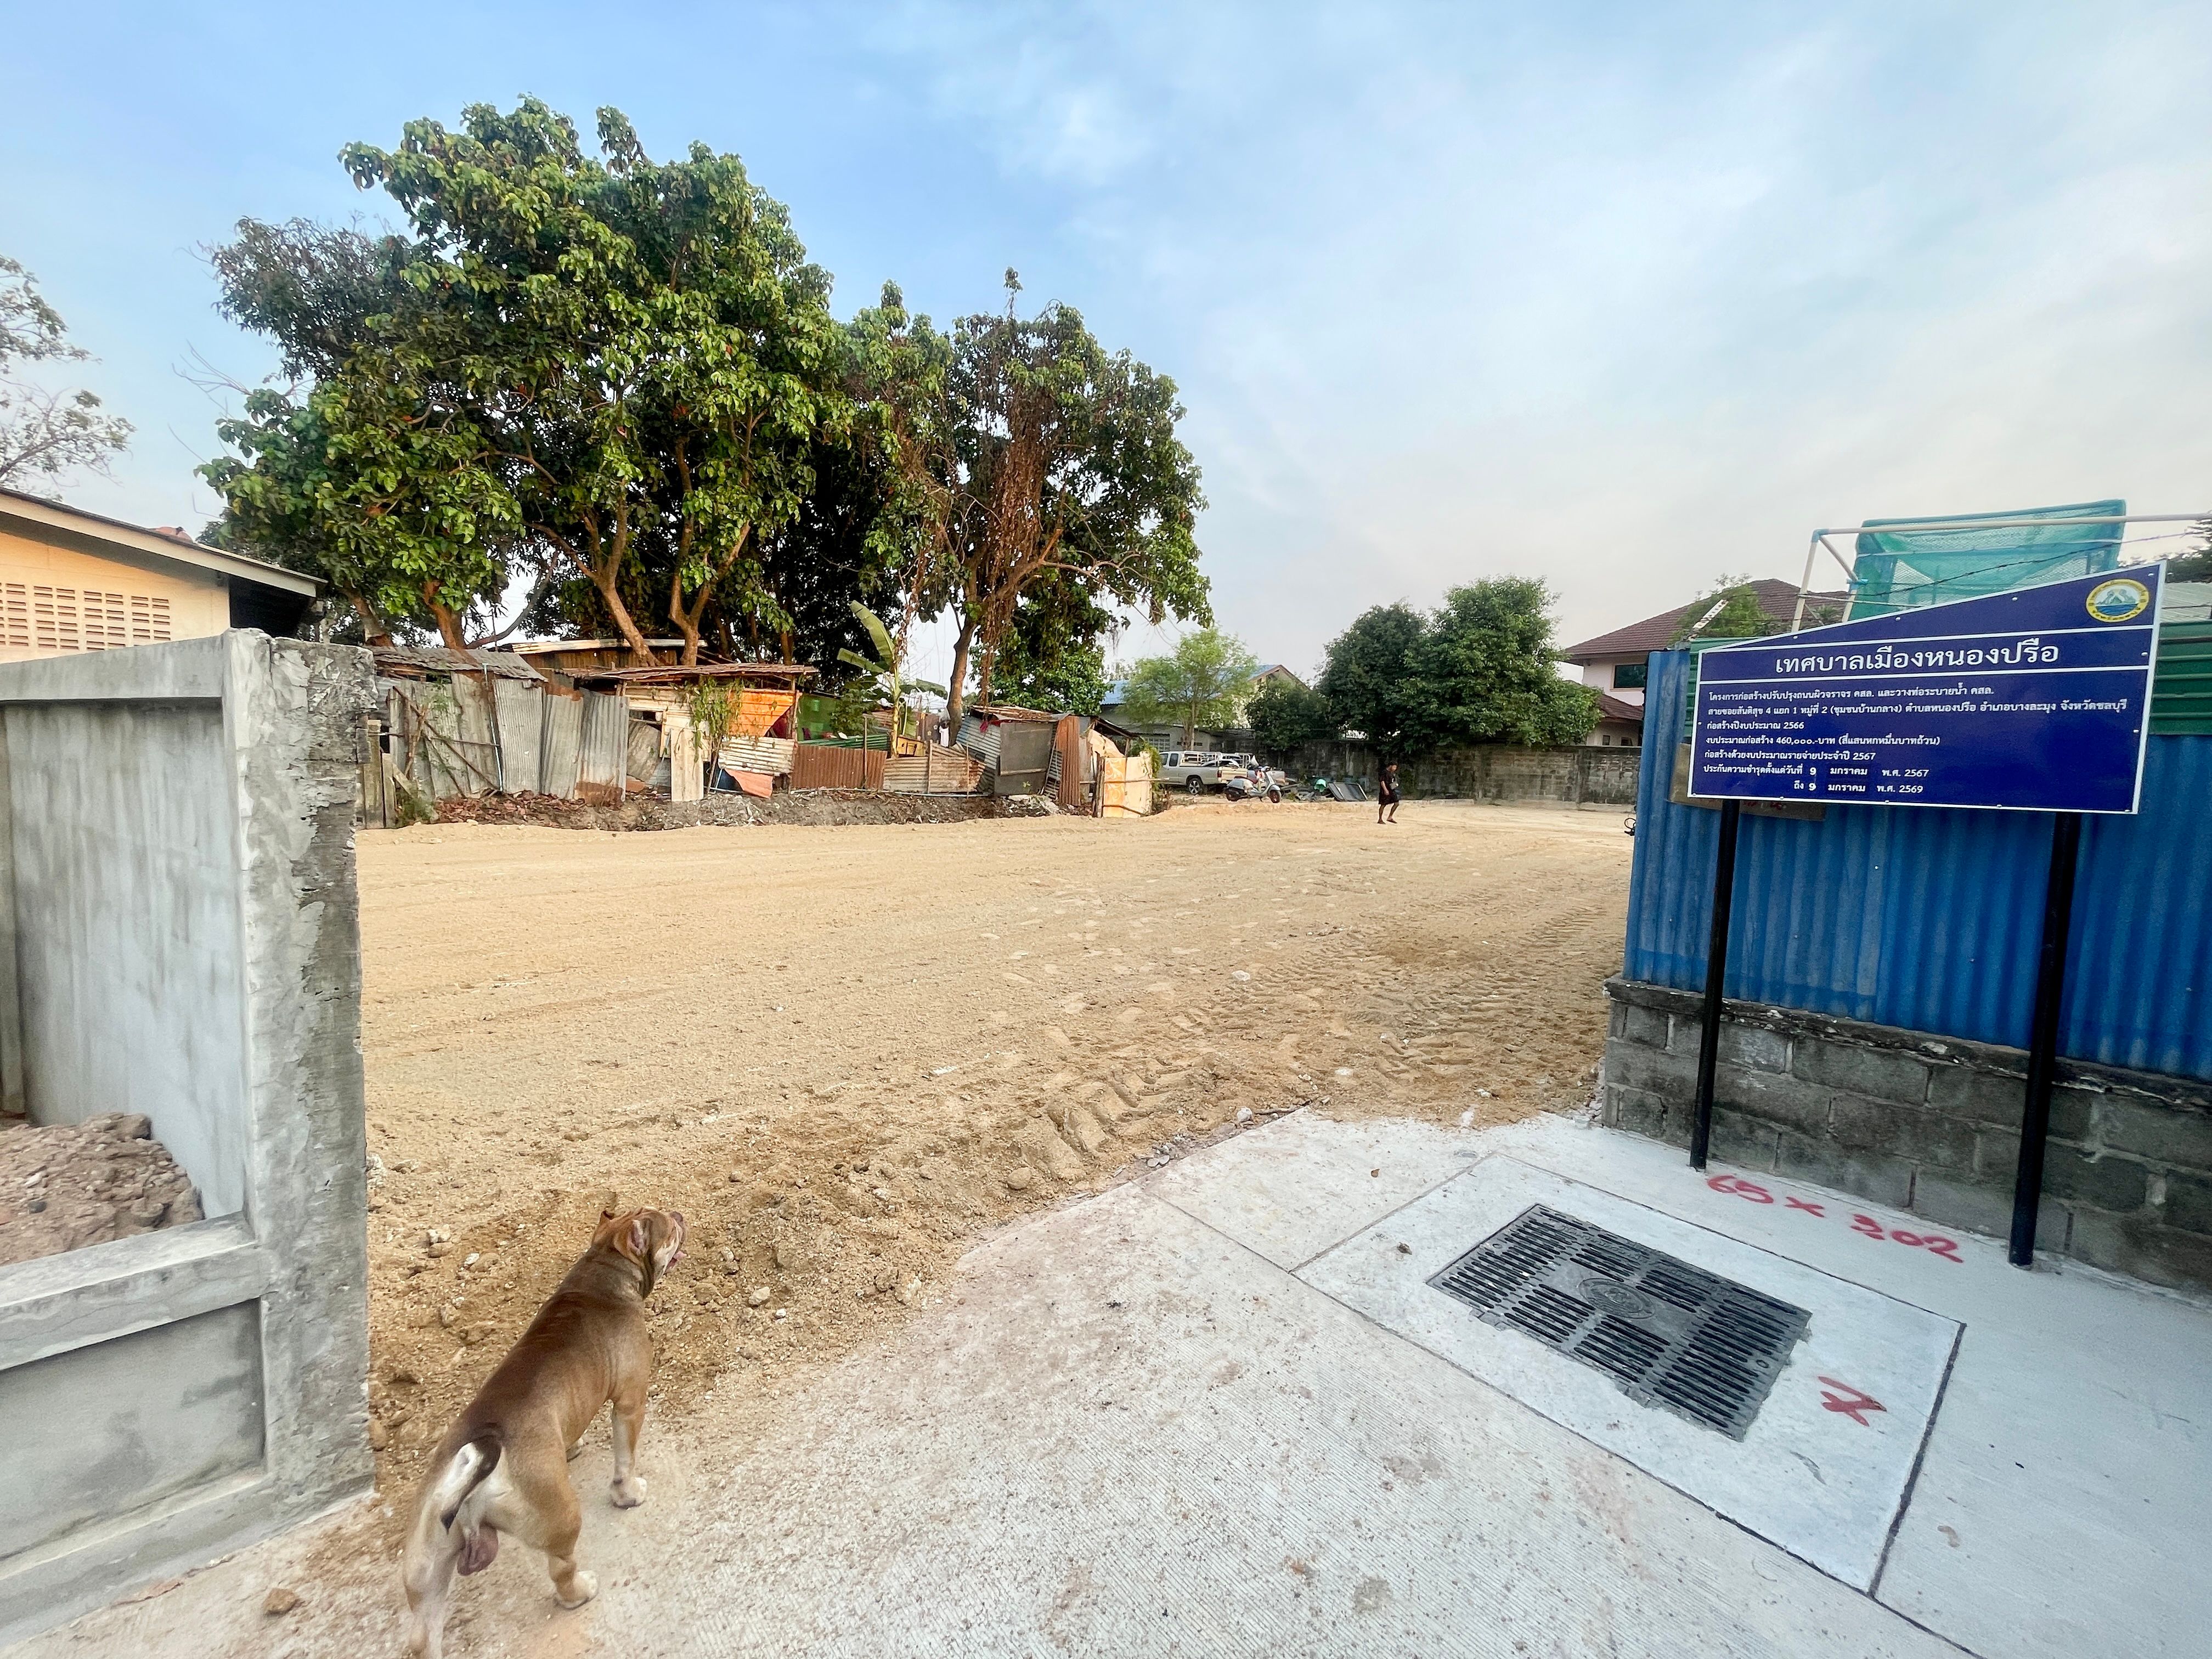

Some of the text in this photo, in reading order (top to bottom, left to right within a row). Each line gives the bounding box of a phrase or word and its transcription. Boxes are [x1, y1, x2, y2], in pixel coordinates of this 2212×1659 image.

[1775, 637, 2059, 673] เทศบาลเมืองหนองปรือ
[1852, 752, 1876, 760] 2567
[1809, 767, 1816, 776] 9
[1904, 769, 1929, 777] 2567
[1794, 780, 1804, 789] ถึง
[1809, 783, 1816, 791] 9
[1899, 785, 1923, 793] 2569
[1707, 1175, 1774, 1204] 65
[1851, 1214, 1963, 1263] 302
